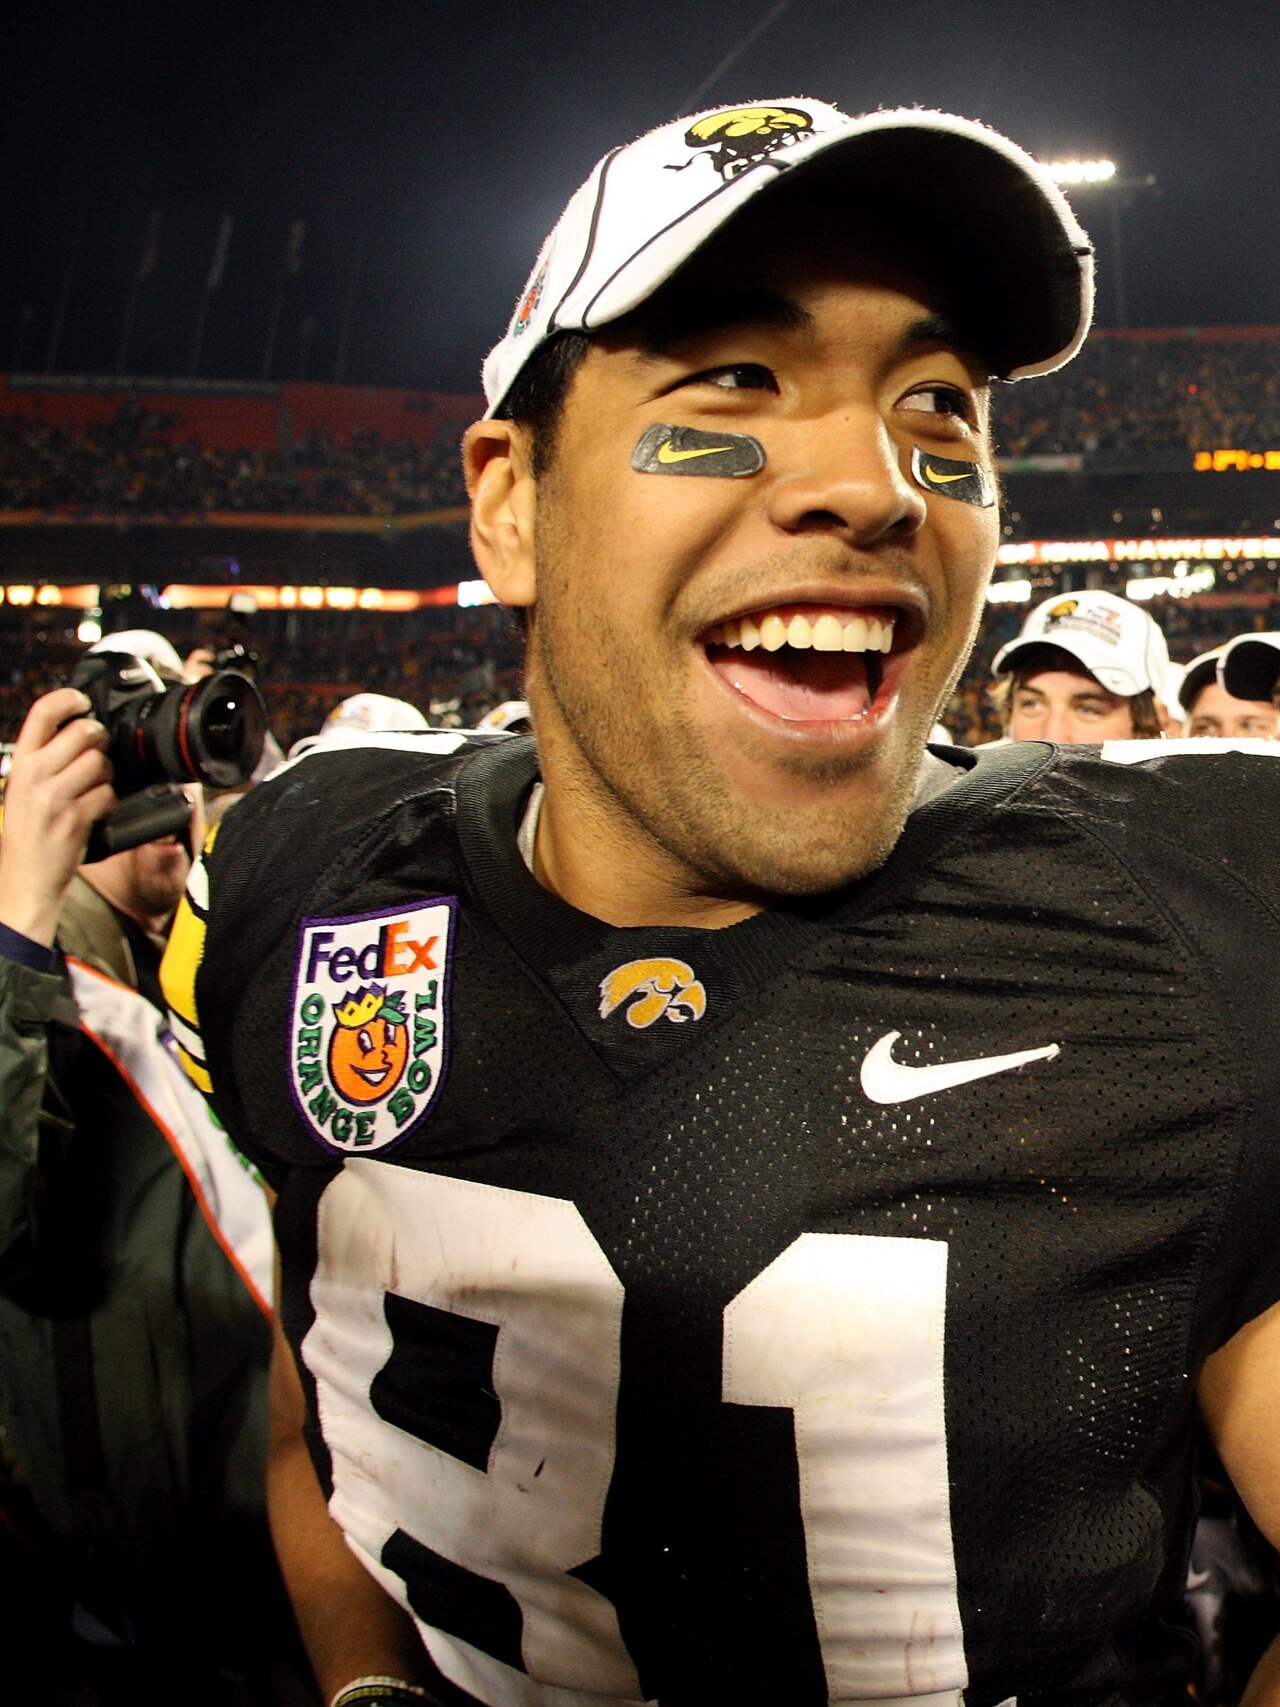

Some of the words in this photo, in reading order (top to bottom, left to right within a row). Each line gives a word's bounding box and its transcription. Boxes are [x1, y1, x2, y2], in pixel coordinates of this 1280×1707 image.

[305, 921, 440, 983] FedEx
[297, 992, 377, 1147] ORANGE
[387, 979, 439, 1129] BOWL
[302, 1157, 1016, 1707] 81
